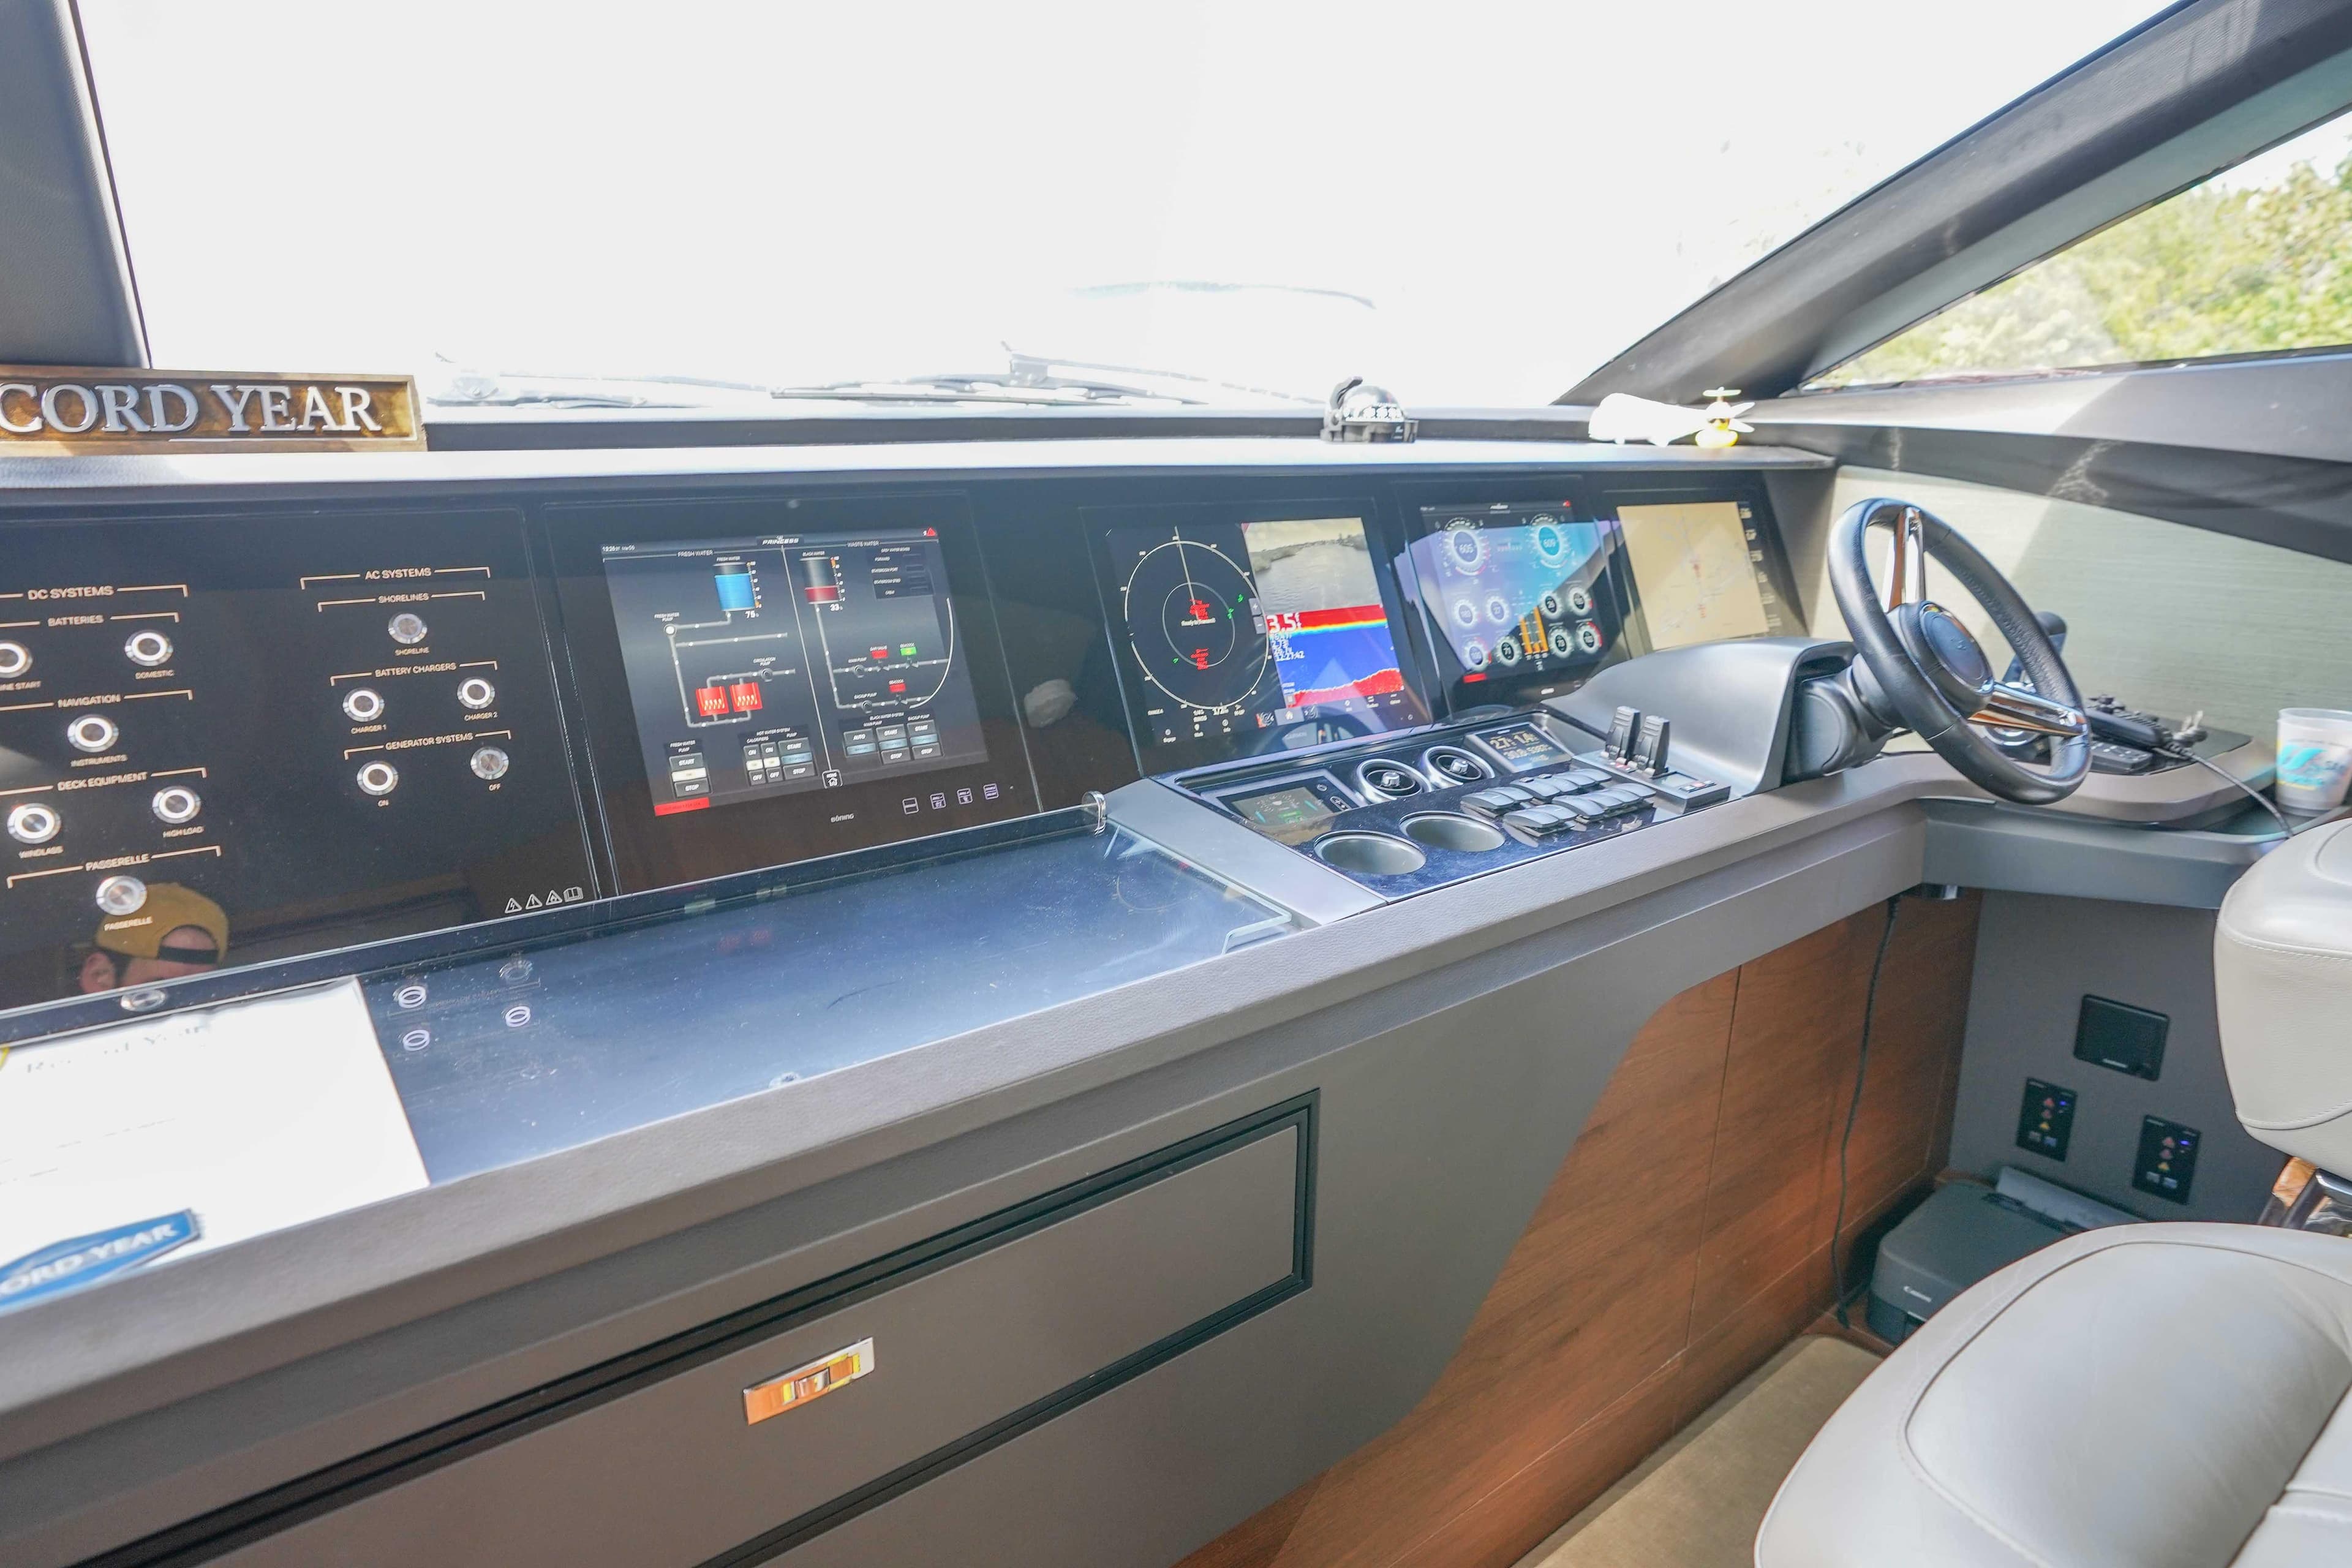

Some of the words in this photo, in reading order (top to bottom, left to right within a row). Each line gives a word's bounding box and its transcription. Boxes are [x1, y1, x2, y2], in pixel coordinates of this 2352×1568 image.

[0, 383, 200, 433] CORD
[211, 385, 382, 433] YEAR
[365, 570, 382, 579] AC
[382, 568, 431, 578] SYSTEMS
[28, 590, 48, 600] DC
[50, 586, 114, 599] SYSTEMS
[378, 593, 429, 603] SHORELINES
[47, 614, 104, 627] BATTERIES
[1267, 613, 1297, 633] 3.5
[394, 647, 429, 656] SHORELINE
[135, 669, 174, 680] DOMESTIC
[375, 666, 411, 677] BATTERY
[412, 662, 456, 674] CHARGERS
[57, 694, 121, 708] NAVIGATION
[385, 737, 435, 750] GENERATOR
[435, 733, 473, 744] SYSTEMS
[58, 781, 87, 791] DECK
[88, 771, 148, 788] EQUIPMENT
[163, 829, 184, 838] HIGH
[183, 826, 204, 836] LOAD
[85, 853, 149, 871] PASSERELLE
[104, 916, 153, 931] PASSERELLE
[90, 1223, 178, 1259] YEAR
